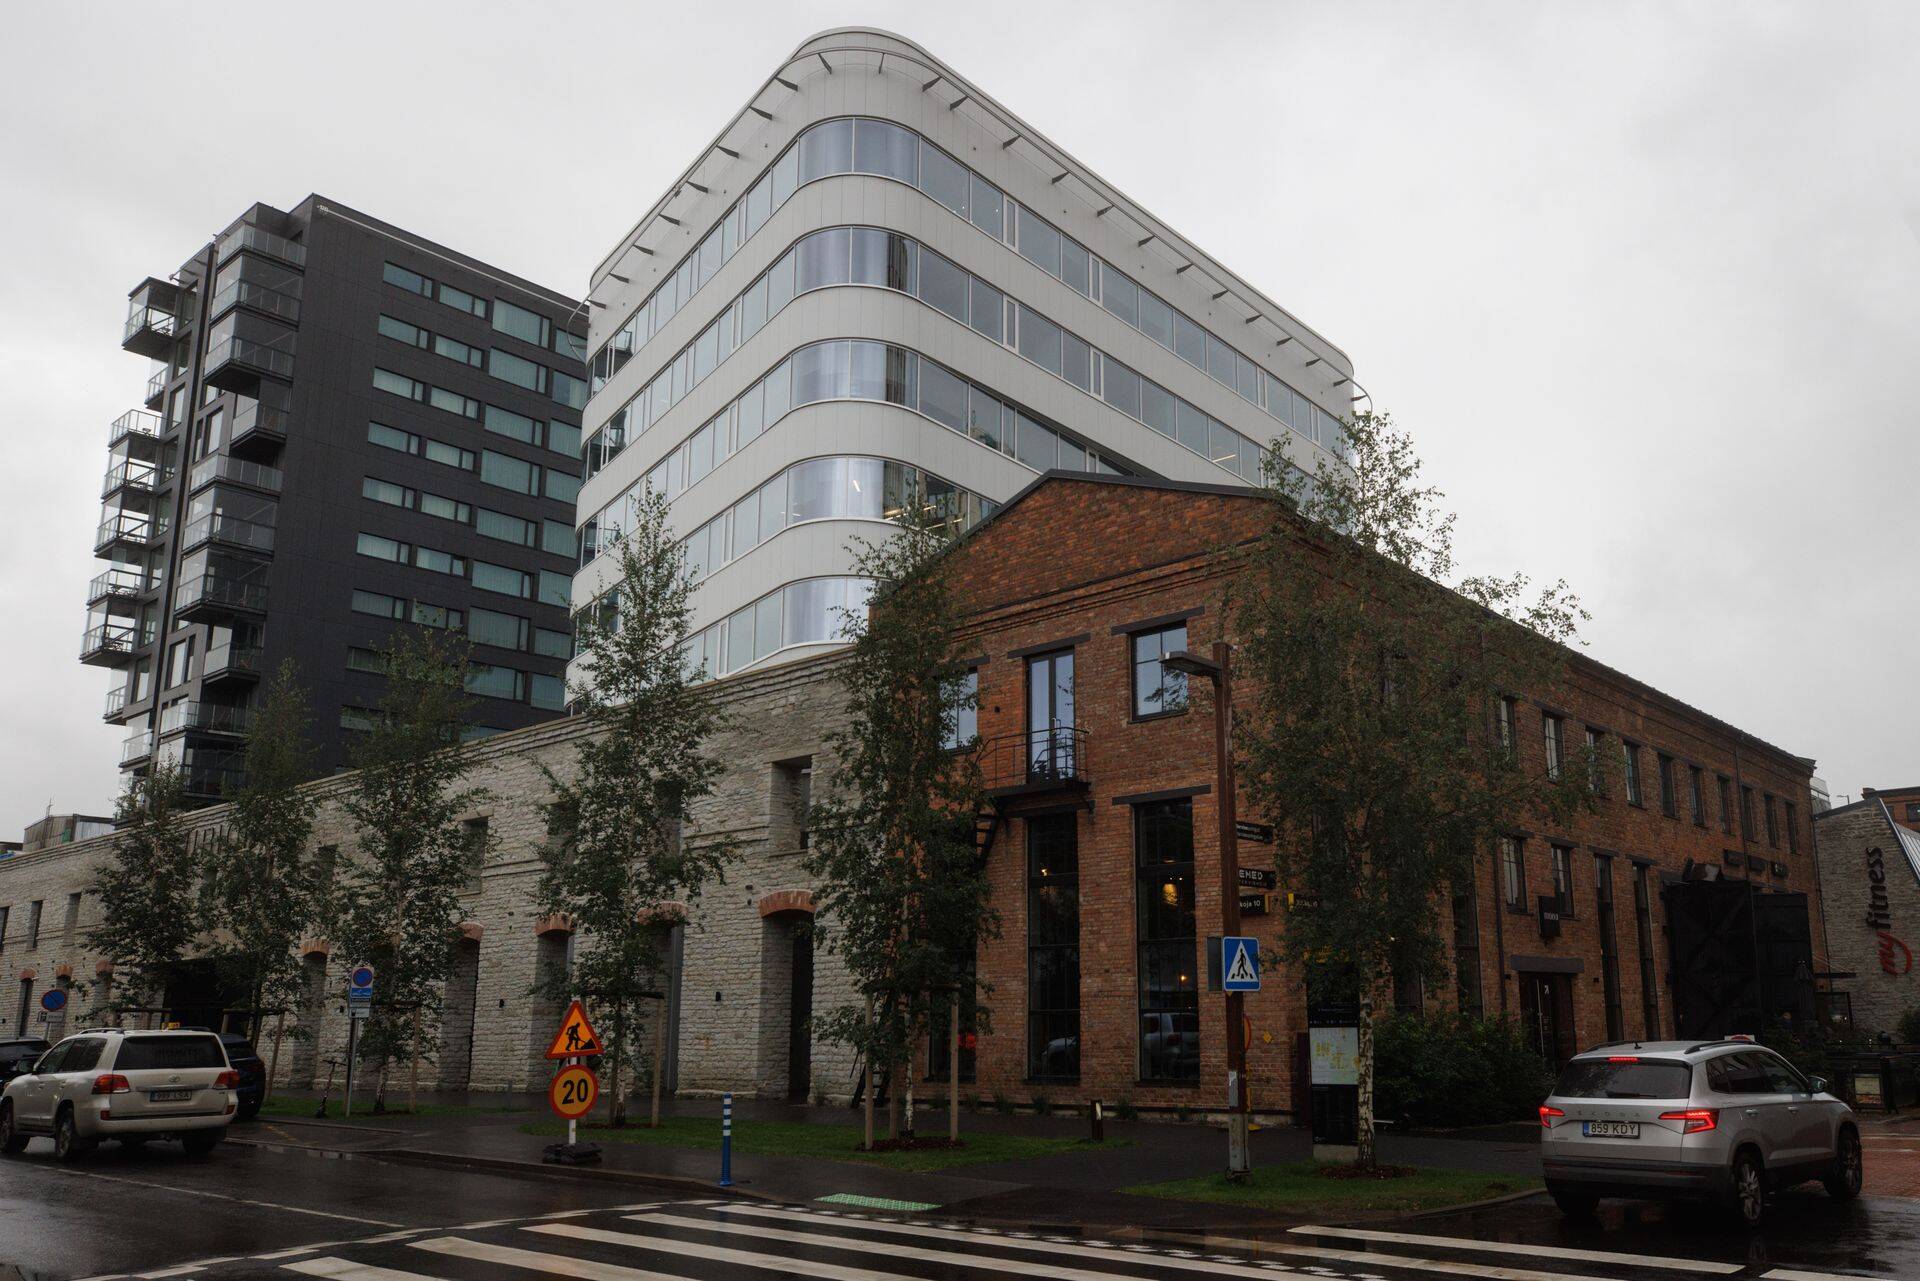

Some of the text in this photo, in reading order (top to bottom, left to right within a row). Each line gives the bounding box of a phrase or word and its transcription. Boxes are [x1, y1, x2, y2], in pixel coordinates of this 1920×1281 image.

[562, 1078, 588, 1104] 20
[1591, 1123, 1635, 1134] 859 KDY
